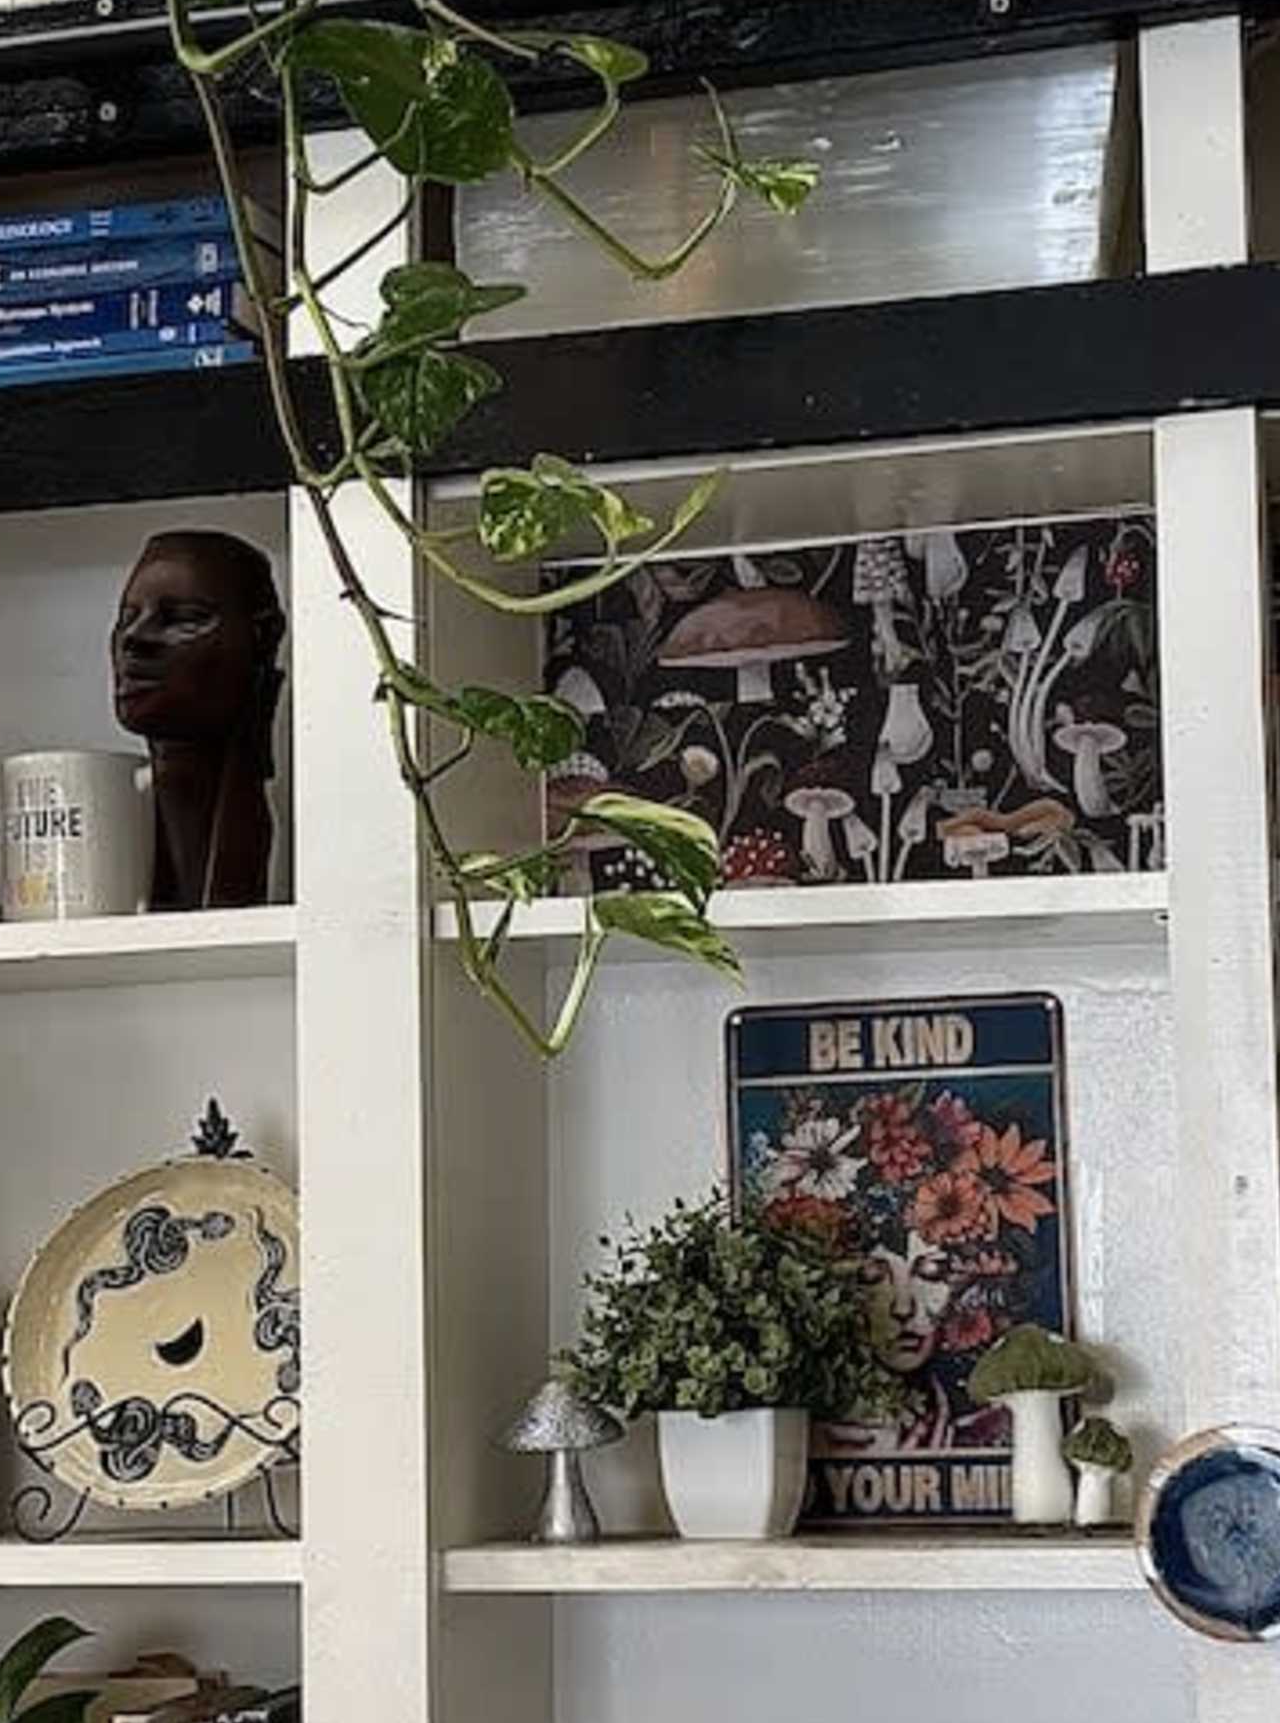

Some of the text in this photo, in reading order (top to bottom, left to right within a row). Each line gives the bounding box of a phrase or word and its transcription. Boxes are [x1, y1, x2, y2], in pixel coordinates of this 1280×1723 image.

[809, 1014, 975, 1071] BE KIND
[827, 1464, 941, 1513] YOUR
